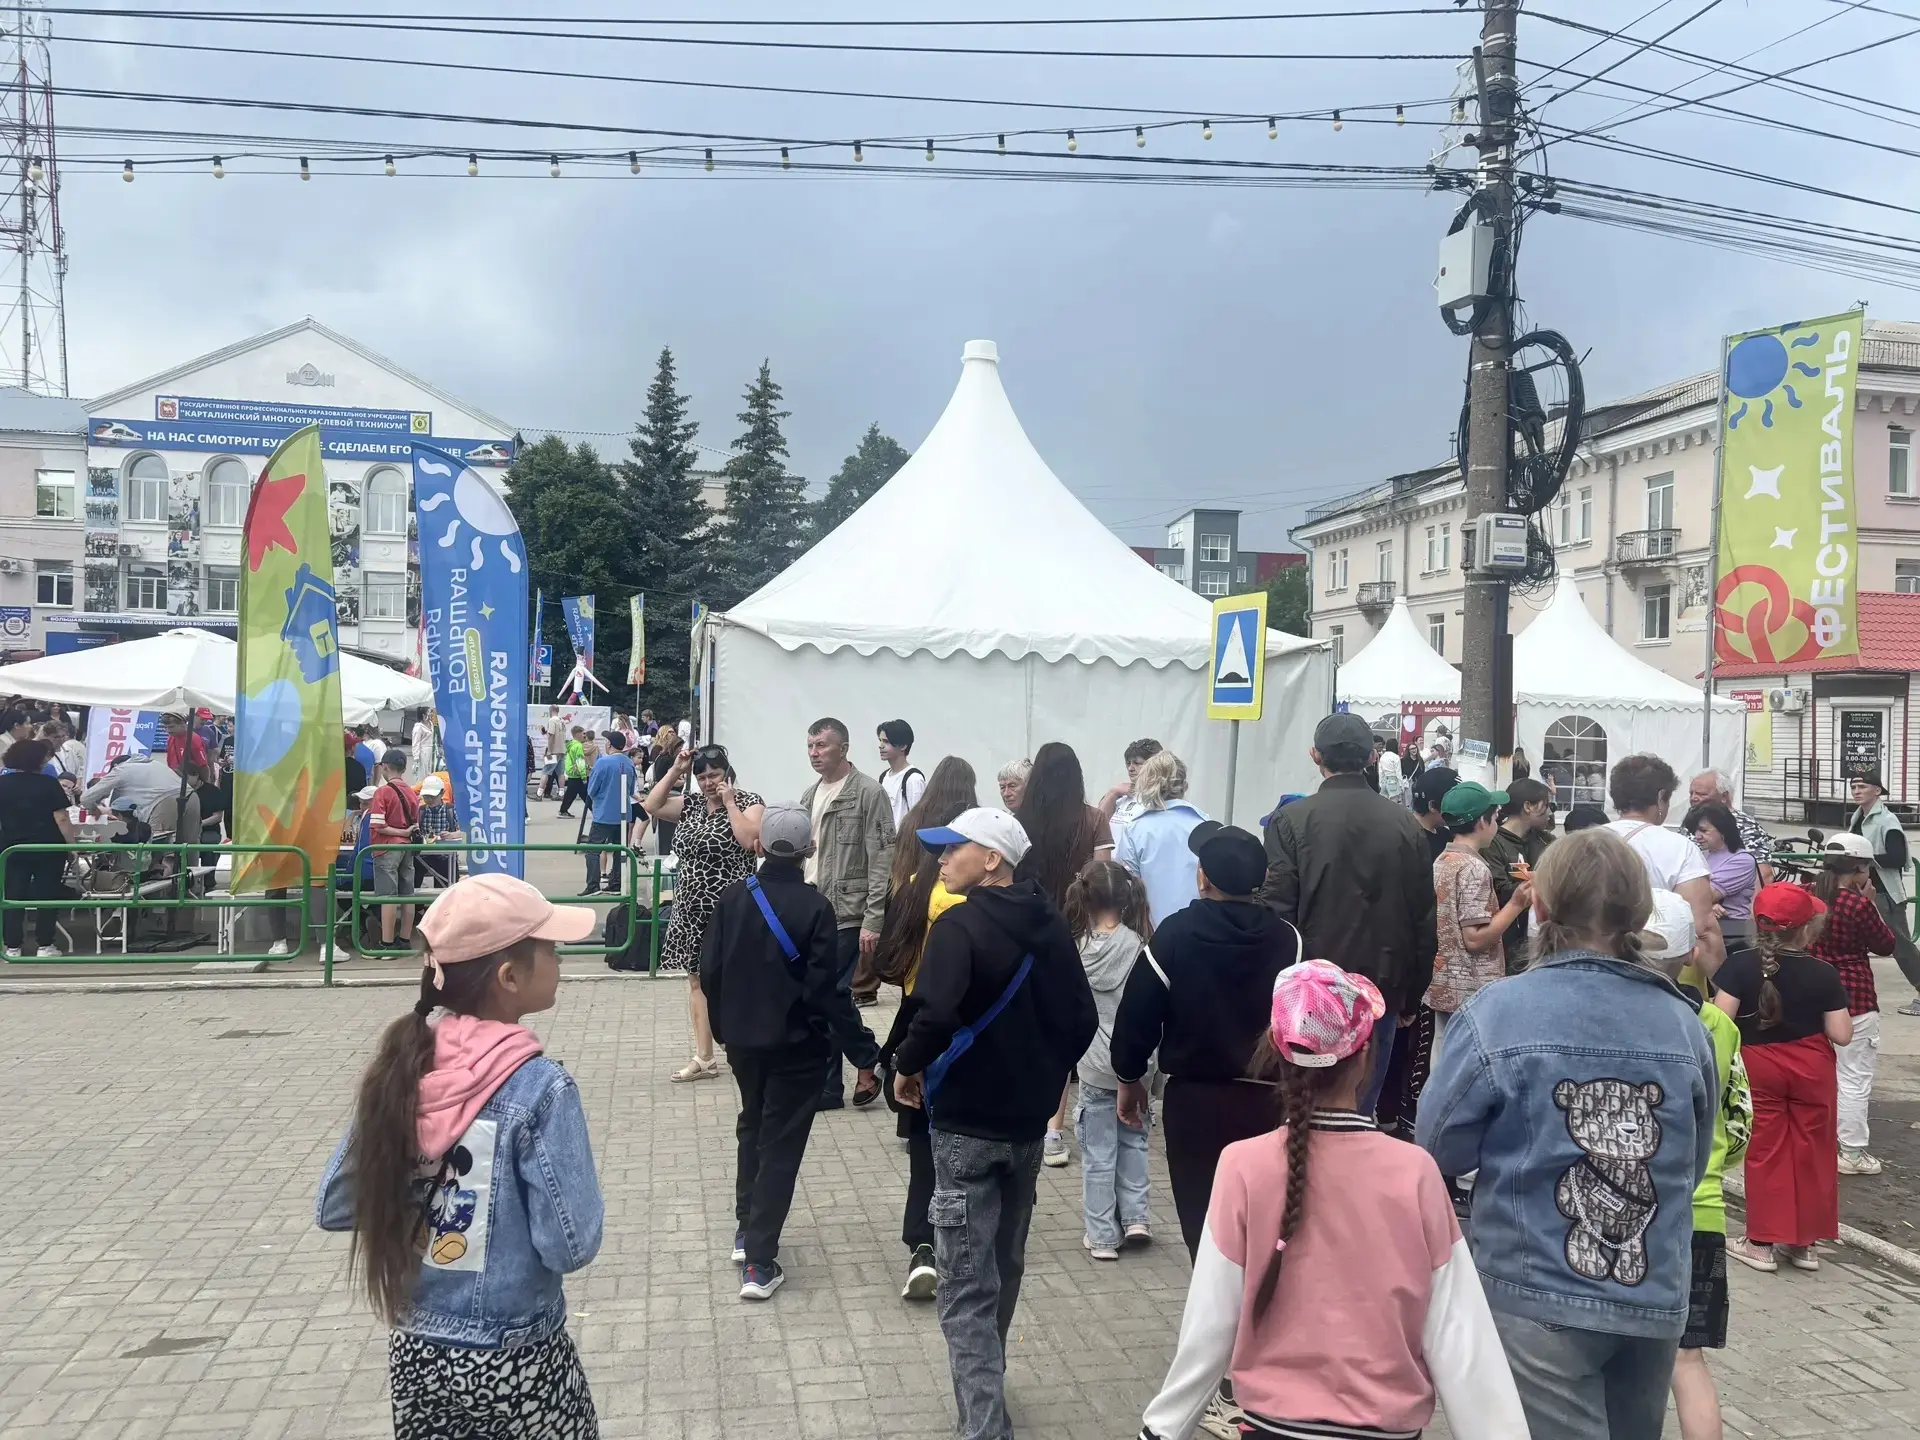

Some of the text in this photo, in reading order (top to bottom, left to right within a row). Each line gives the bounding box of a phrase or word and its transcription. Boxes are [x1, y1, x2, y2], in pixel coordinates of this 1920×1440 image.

[180, 401, 240, 411] ГОСУДАРСТВЕННОЕ
[241, 405, 307, 415] ПРОФЕССИОНАЛЬНОЕ
[308, 409, 367, 418] ОБРАЗОВАТЕЛЬНОЕ
[180, 410, 407, 430] "КАРТАЛИНСКИЙ МНОГООТРАСЛЕВОЙ ТЕХНИКУМ"
[147, 431, 165, 441] НА
[169, 432, 194, 443] НАС
[198, 433, 259, 447] СМОТРИТ
[328, 441, 387, 454] СДЕЛАЕМ
[389, 444, 412, 454] ЕГО
[1810, 330, 1850, 648] ФЕСТИВАЛЬ
